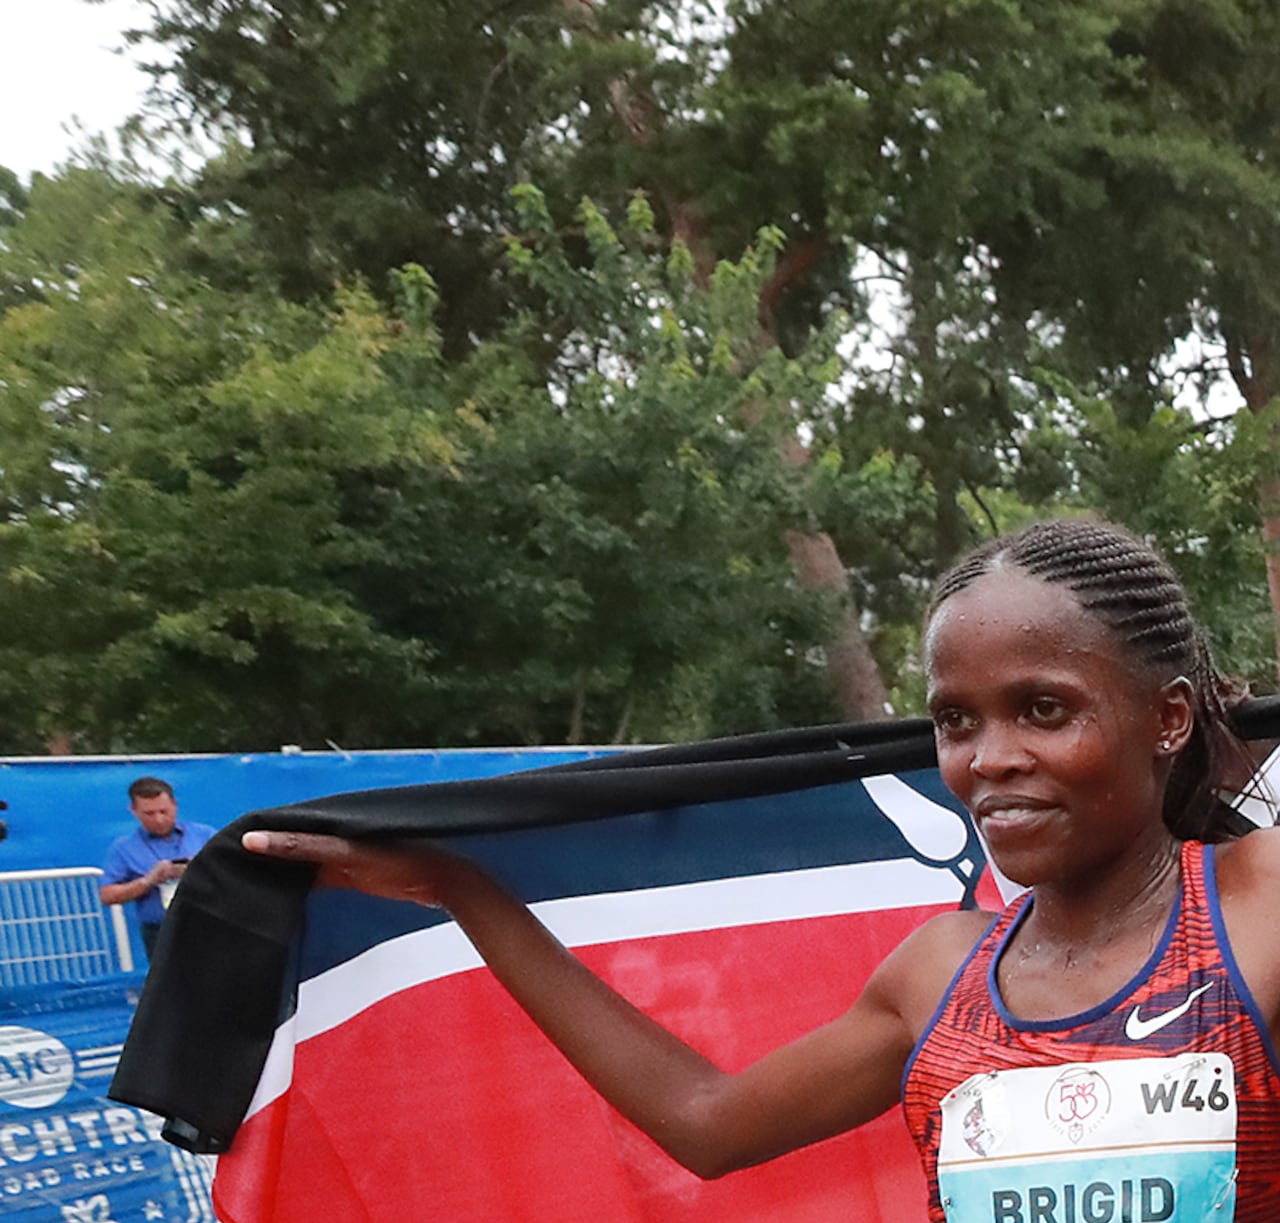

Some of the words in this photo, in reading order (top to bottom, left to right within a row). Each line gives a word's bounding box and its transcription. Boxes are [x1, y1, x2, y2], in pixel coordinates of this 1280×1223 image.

[1140, 1079, 1230, 1114] W46
[0, 1168, 61, 1198] OAD
[72, 1155, 145, 1180] RACE
